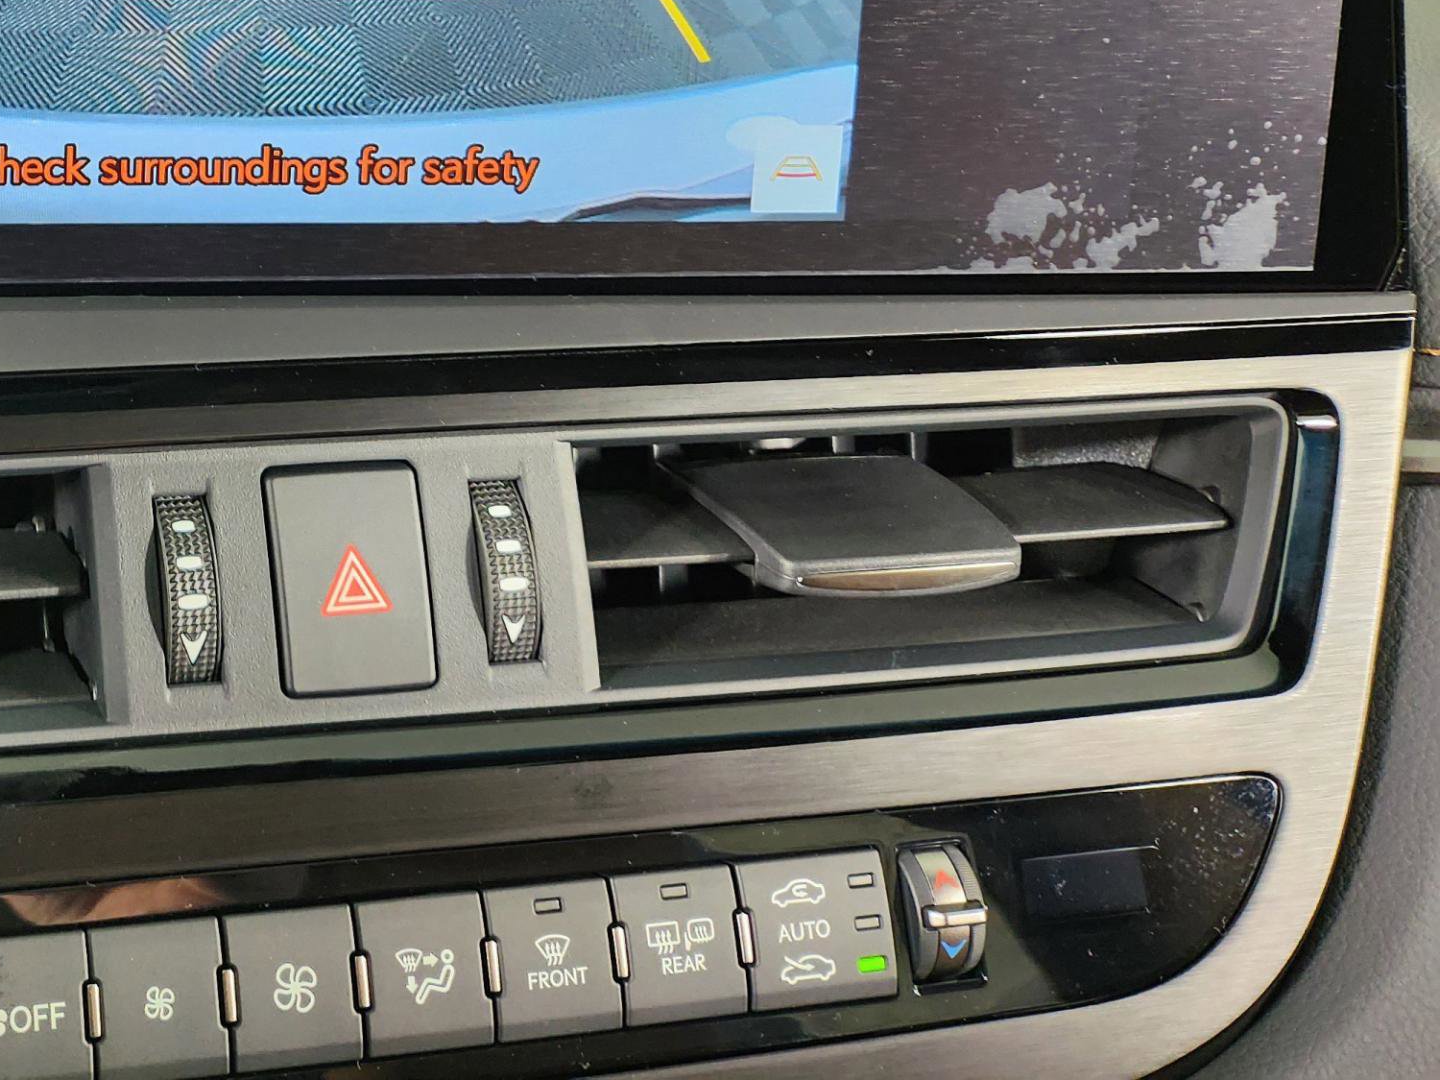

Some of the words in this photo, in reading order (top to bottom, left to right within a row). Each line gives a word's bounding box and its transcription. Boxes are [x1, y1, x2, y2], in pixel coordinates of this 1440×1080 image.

[98, 144, 348, 194] surroundings
[357, 144, 414, 187] for
[422, 145, 541, 194] safety
[778, 919, 832, 944] AUTO
[660, 952, 707, 976] REAR
[527, 966, 588, 991] FRONT
[9, 1001, 67, 1034] OFF
